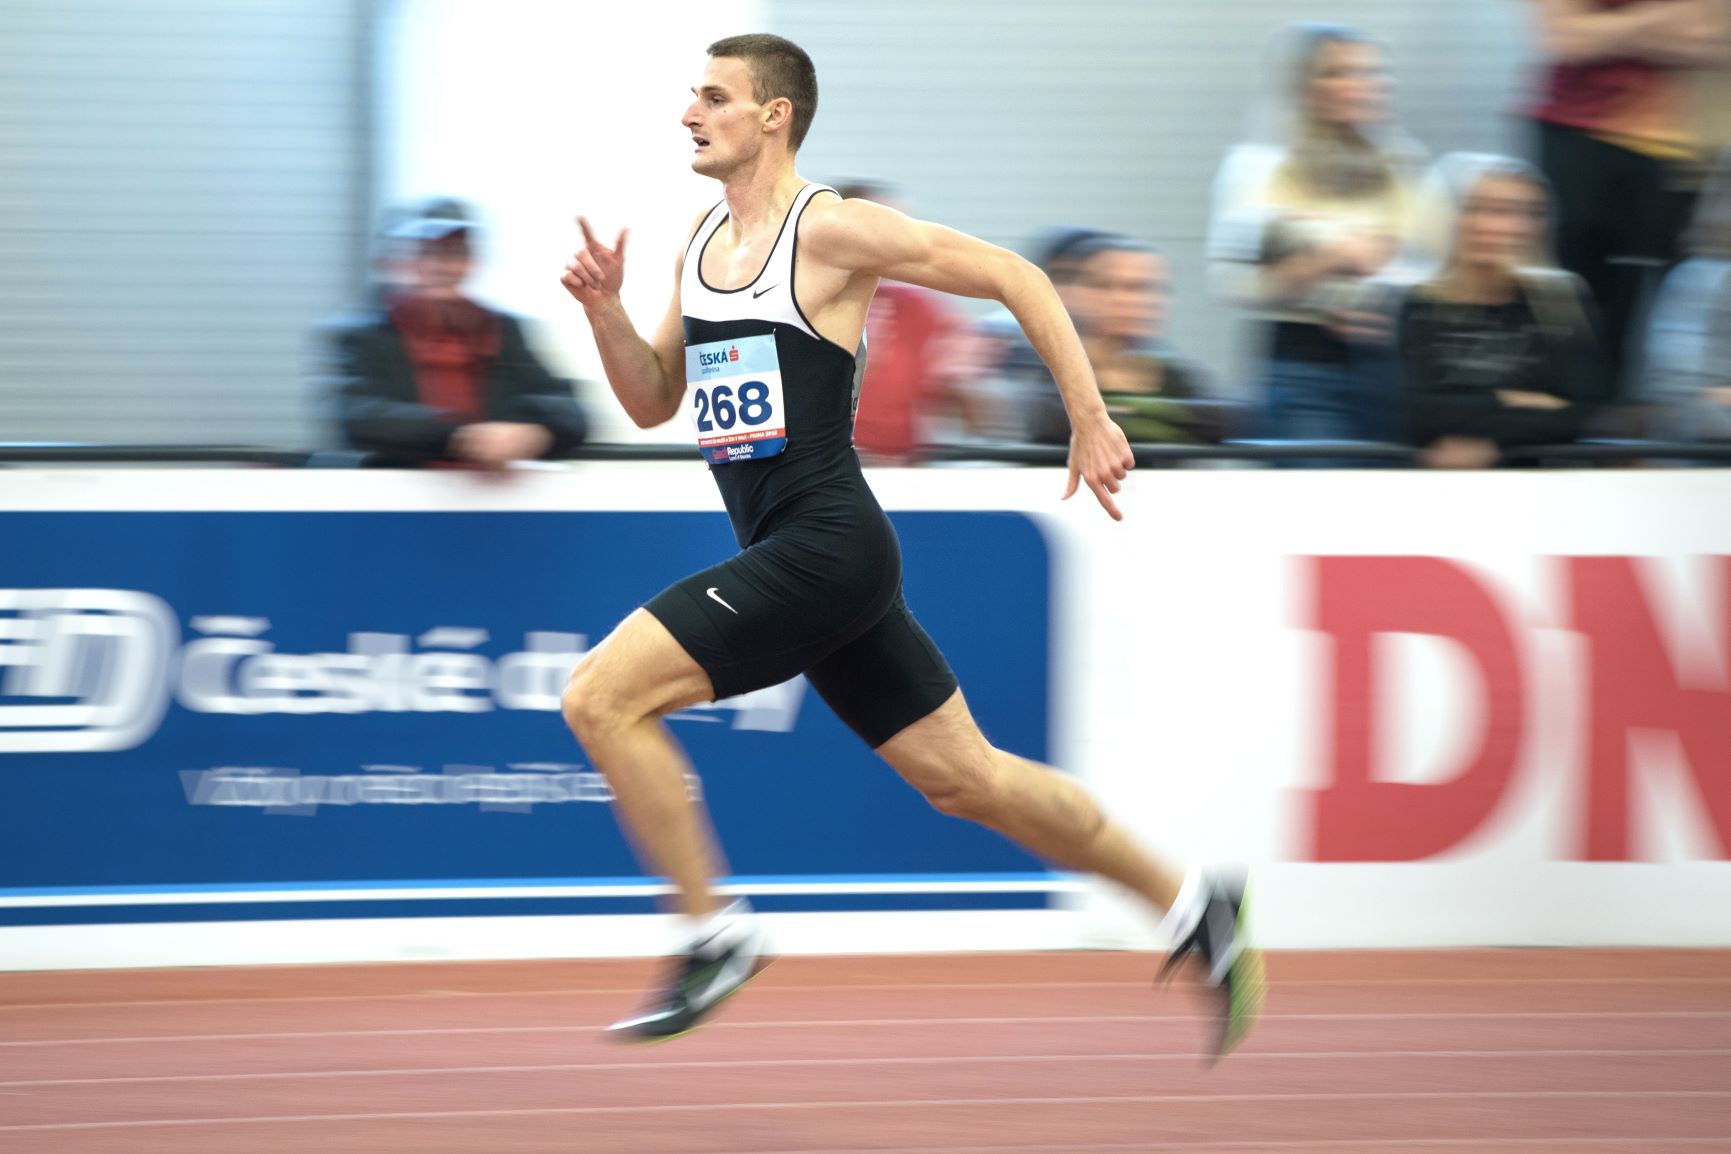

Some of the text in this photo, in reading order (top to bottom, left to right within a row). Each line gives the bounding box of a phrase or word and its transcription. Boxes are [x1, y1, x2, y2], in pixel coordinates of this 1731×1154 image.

[699, 347, 729, 366] ČESKÁ
[694, 380, 773, 432] 268
[727, 443, 754, 457] Republic
